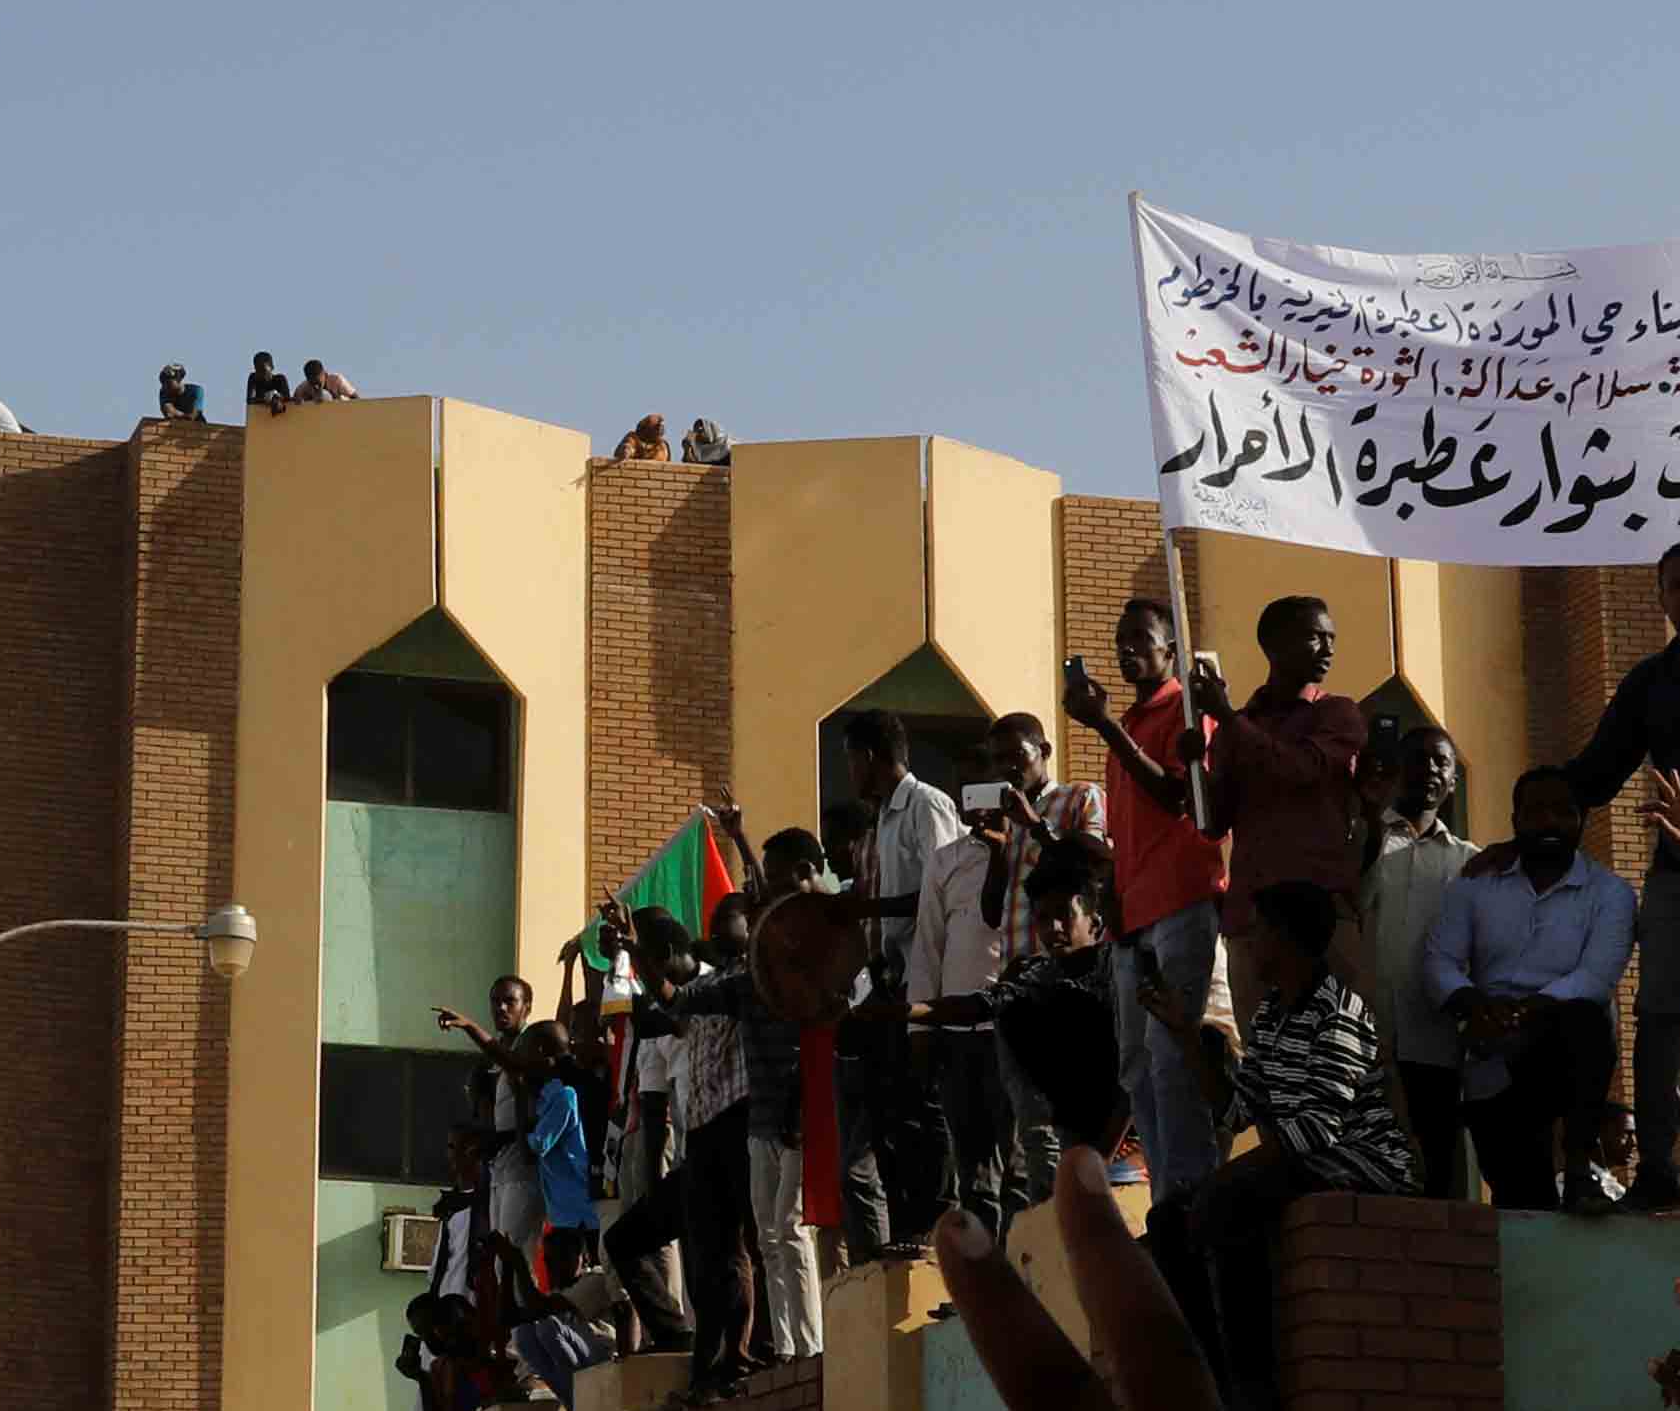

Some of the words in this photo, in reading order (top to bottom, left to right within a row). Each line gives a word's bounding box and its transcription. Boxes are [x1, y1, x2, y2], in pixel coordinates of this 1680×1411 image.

[1158, 255, 1267, 321] بالخرطوم
[1279, 280, 1362, 334] الخيرية
[1581, 301, 1623, 355] حي
[1282, 338, 1351, 395] خيار
[1352, 347, 1441, 397] الثورة
[1160, 389, 1343, 507] الأحرار
[1499, 421, 1648, 534] بثوار
